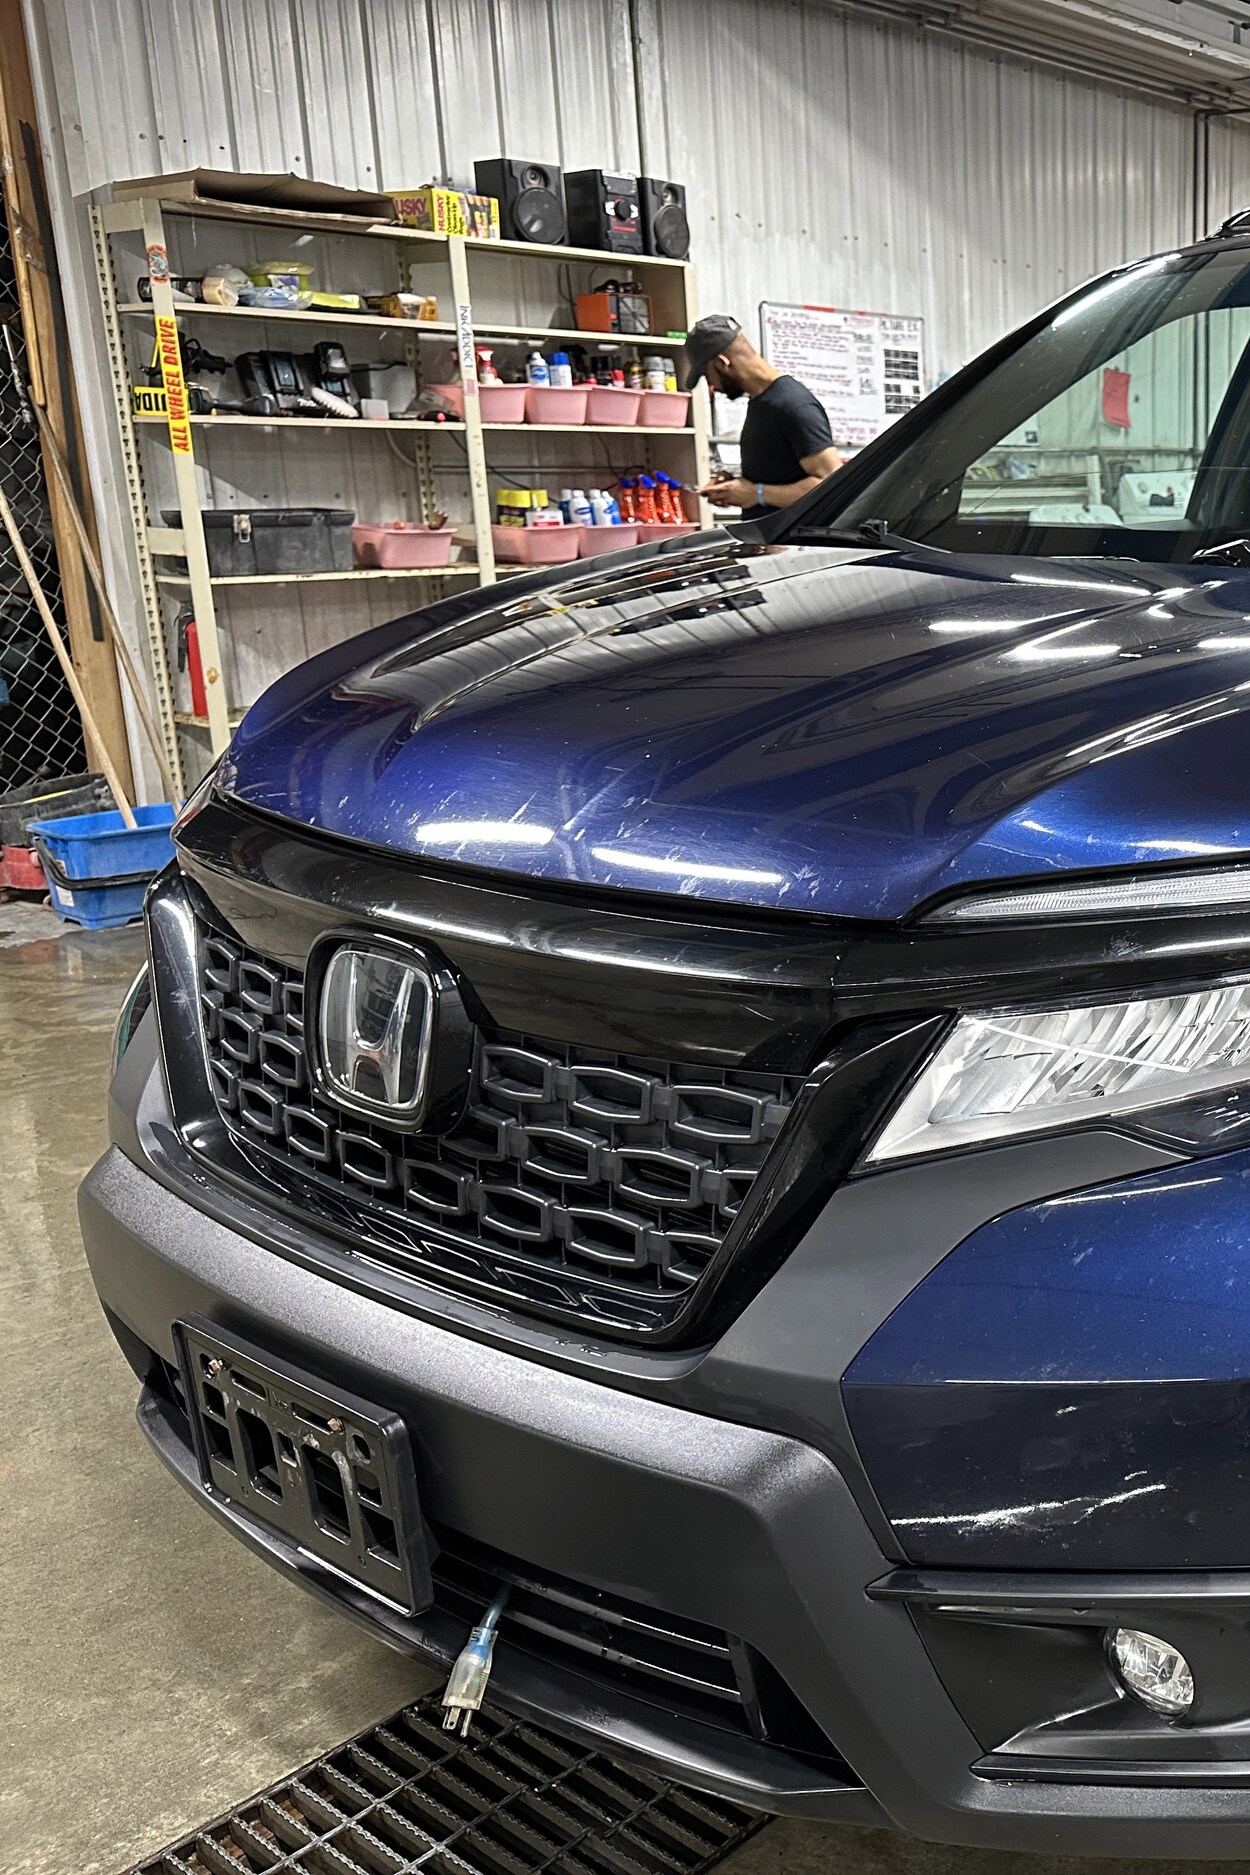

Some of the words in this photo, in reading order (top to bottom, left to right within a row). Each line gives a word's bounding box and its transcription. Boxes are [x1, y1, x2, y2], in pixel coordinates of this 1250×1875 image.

[395, 198, 426, 215] USKY
[436, 194, 445, 231] HUSKY
[160, 318, 178, 366] DRIVE
[166, 371, 186, 420] WHEEL
[172, 425, 190, 452] ALL
